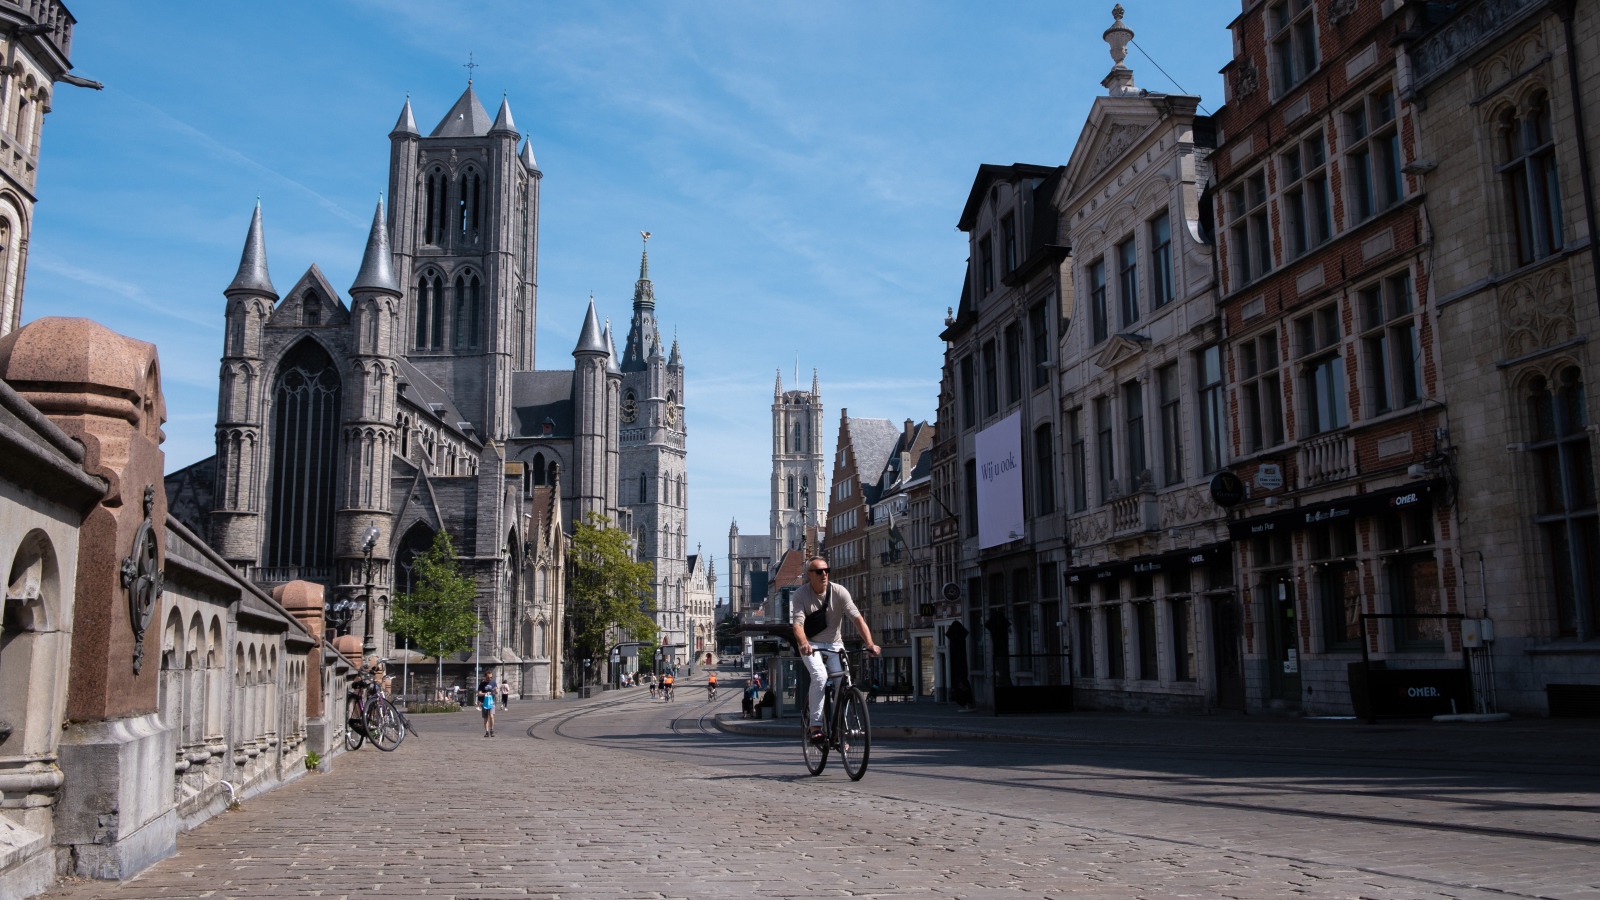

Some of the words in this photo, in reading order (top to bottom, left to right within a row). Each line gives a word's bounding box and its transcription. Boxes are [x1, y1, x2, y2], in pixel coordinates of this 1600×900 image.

[981, 461, 993, 482] Wij
[995, 463, 1000, 476] u
[1001, 451, 1017, 473] ook.
[1395, 493, 1418, 506] OMER.
[1407, 686, 1441, 698] OMER.
